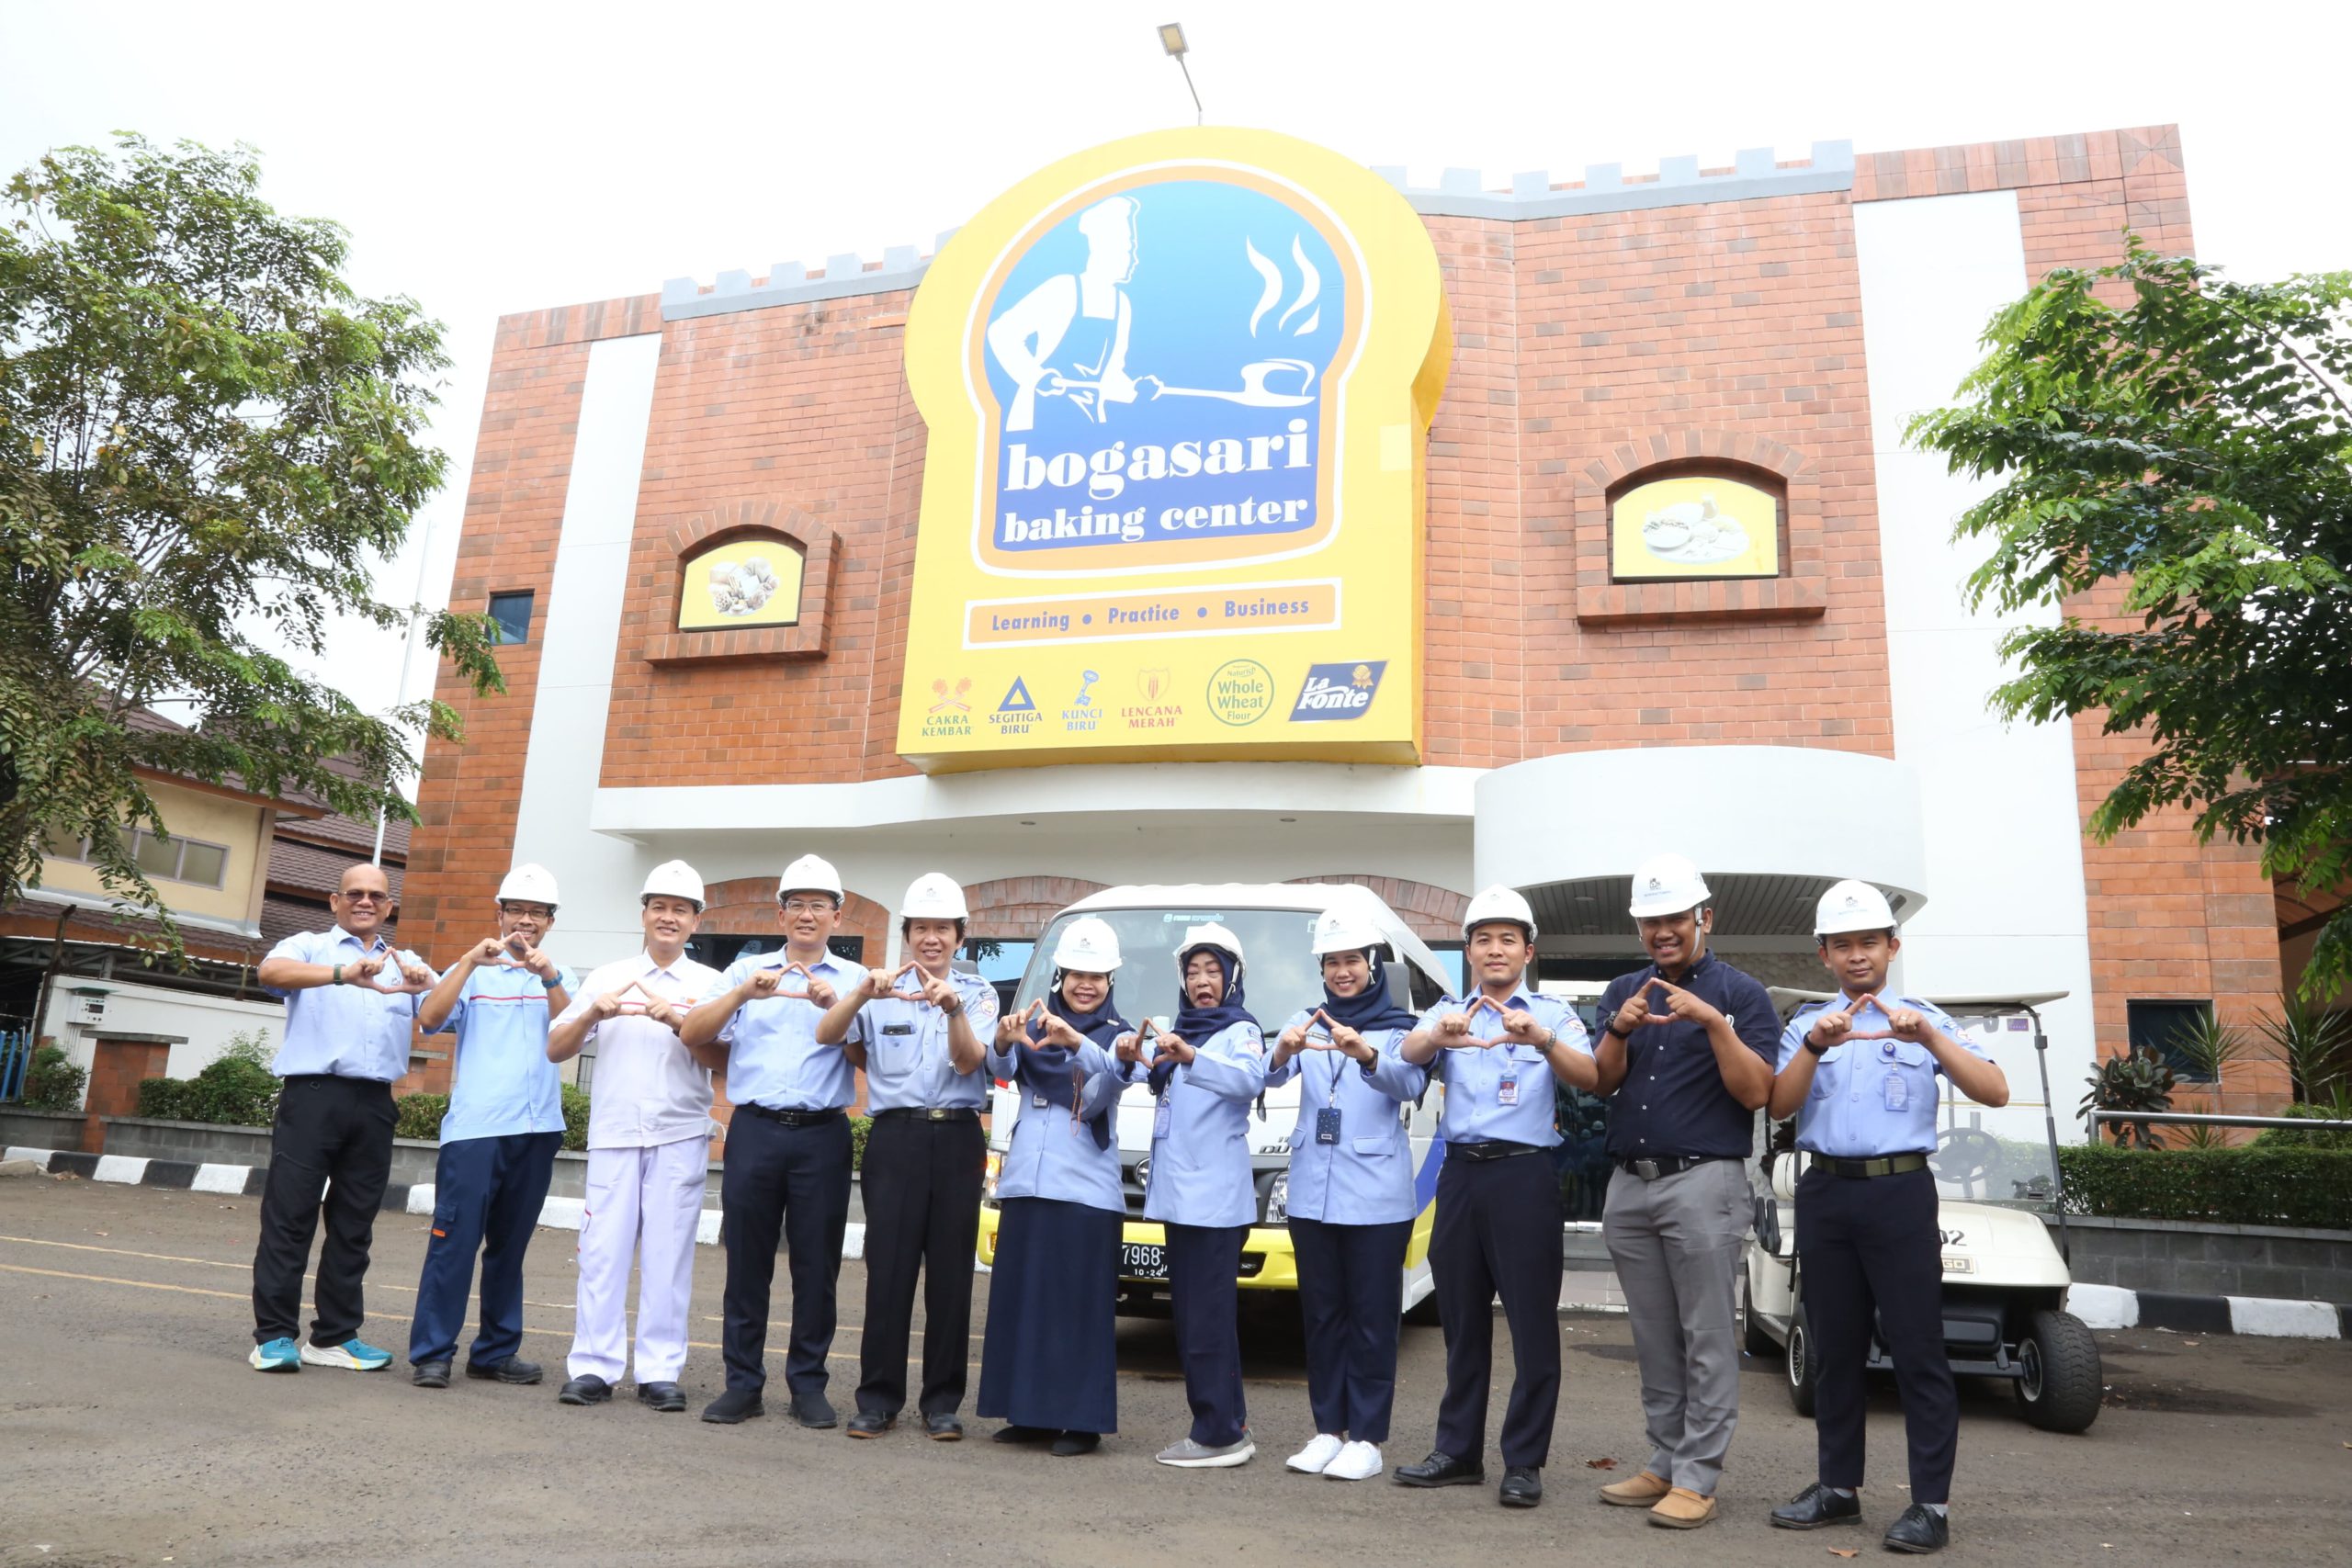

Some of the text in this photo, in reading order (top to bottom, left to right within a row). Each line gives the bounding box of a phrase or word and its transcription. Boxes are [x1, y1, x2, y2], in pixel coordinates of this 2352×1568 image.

[1003, 418, 1312, 501] bogasari
[1002, 496, 1308, 542] baking center
[992, 597, 1309, 632] Learning Practice Business
[1217, 679, 1264, 694] Whole
[1305, 677, 1329, 693] La
[1217, 694, 1264, 709] Wheat
[1297, 689, 1369, 709] Fonte
[1062, 708, 1103, 720] KUNCI
[1121, 705, 1183, 717] LENCANA
[1227, 710, 1251, 720] Flour
[926, 715, 969, 726] CAKRA
[989, 713, 1044, 724] SEGITIGA
[1128, 717, 1176, 728] MERAH
[922, 725, 972, 737] KEMBAR
[1001, 724, 1030, 735] BIRU
[1067, 720, 1097, 731] BIRU
